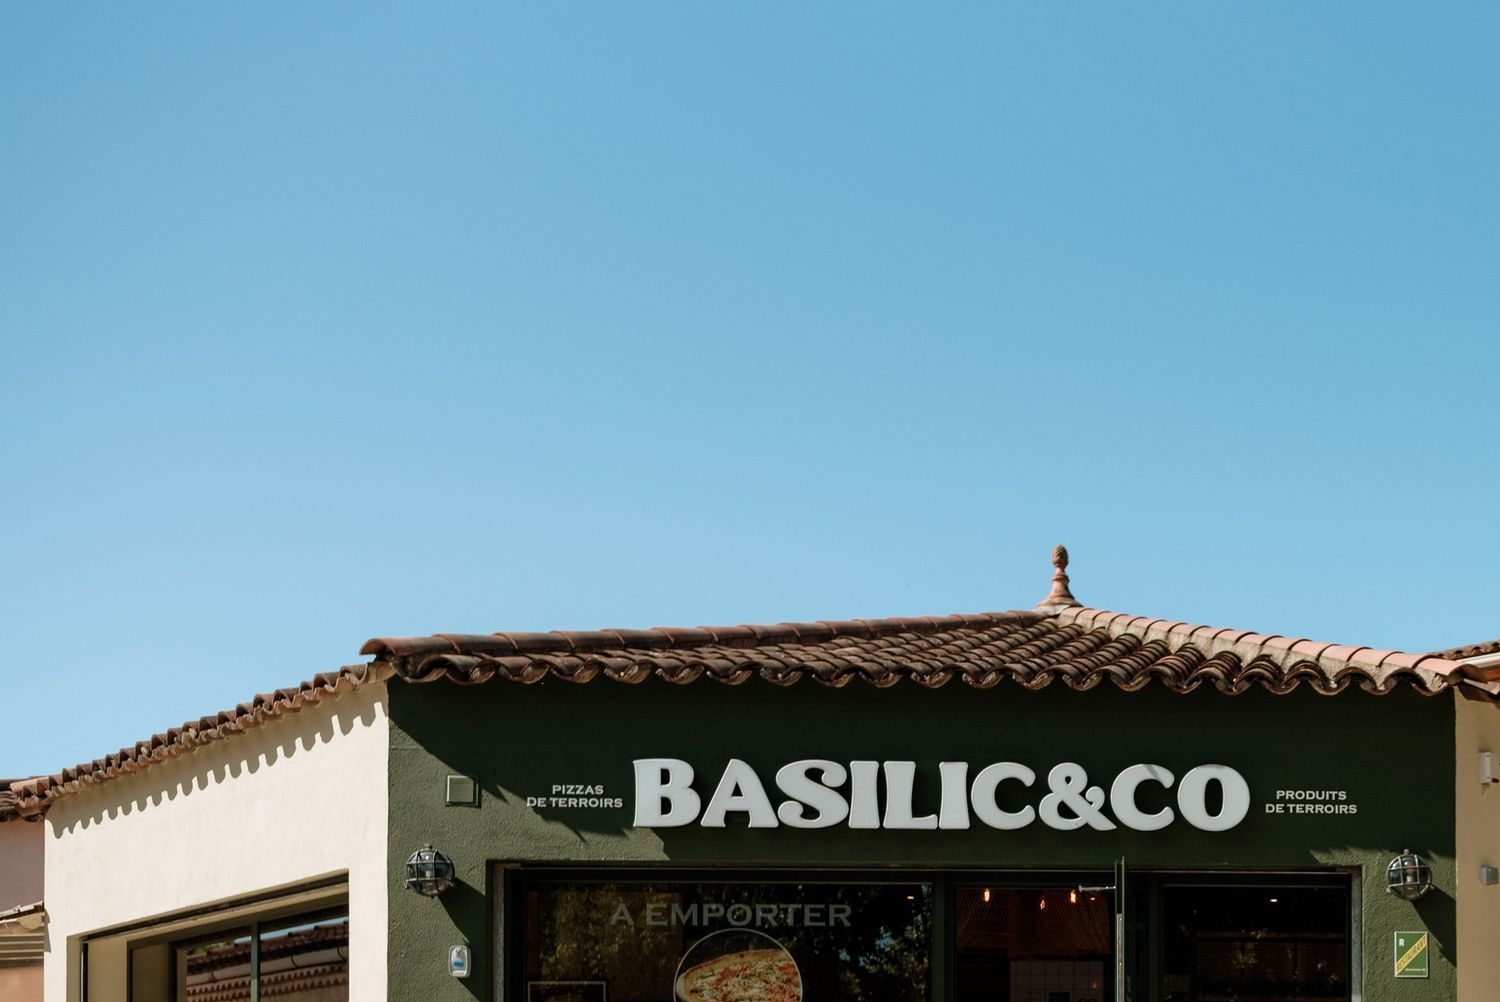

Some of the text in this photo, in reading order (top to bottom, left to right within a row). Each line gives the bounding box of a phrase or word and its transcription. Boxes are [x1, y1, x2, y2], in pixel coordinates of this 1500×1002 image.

[551, 784, 604, 796] PIZZAS
[632, 758, 1251, 832] BASILIC&CO
[1276, 790, 1347, 801] PRODUITS
[526, 797, 623, 809] DE TERROIRS
[1265, 803, 1358, 814] DE TERROIRS
[610, 896, 852, 927] À EMPORTER
[1398, 938, 1405, 947] R
